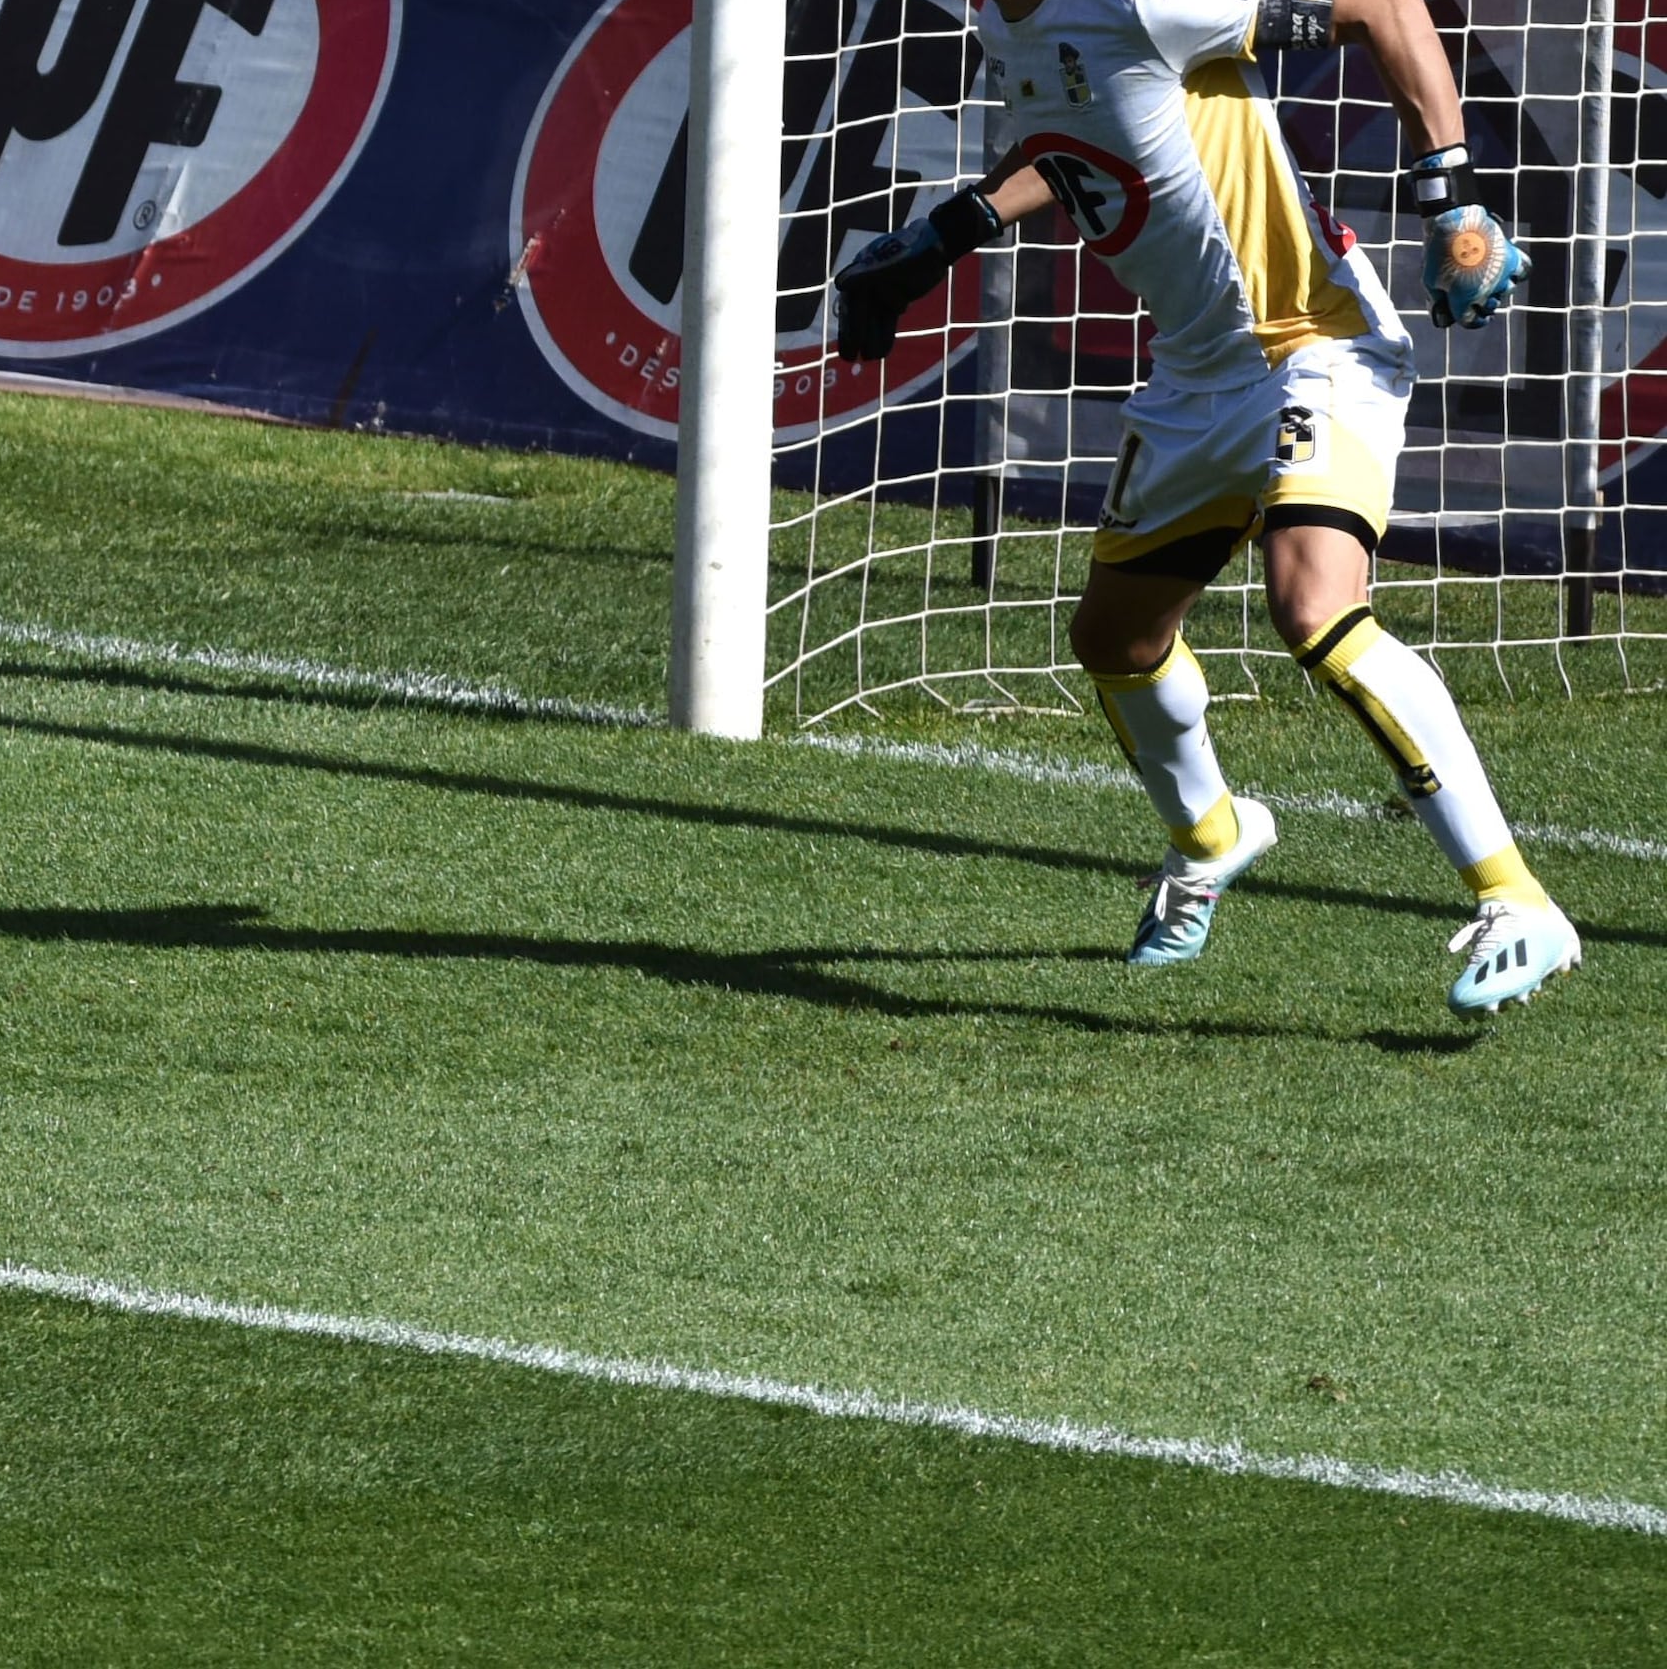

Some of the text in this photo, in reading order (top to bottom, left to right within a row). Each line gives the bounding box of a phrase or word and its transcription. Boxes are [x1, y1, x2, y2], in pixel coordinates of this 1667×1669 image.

[56, 278, 137, 312] 1903
[619, 344, 837, 399] DES 903
